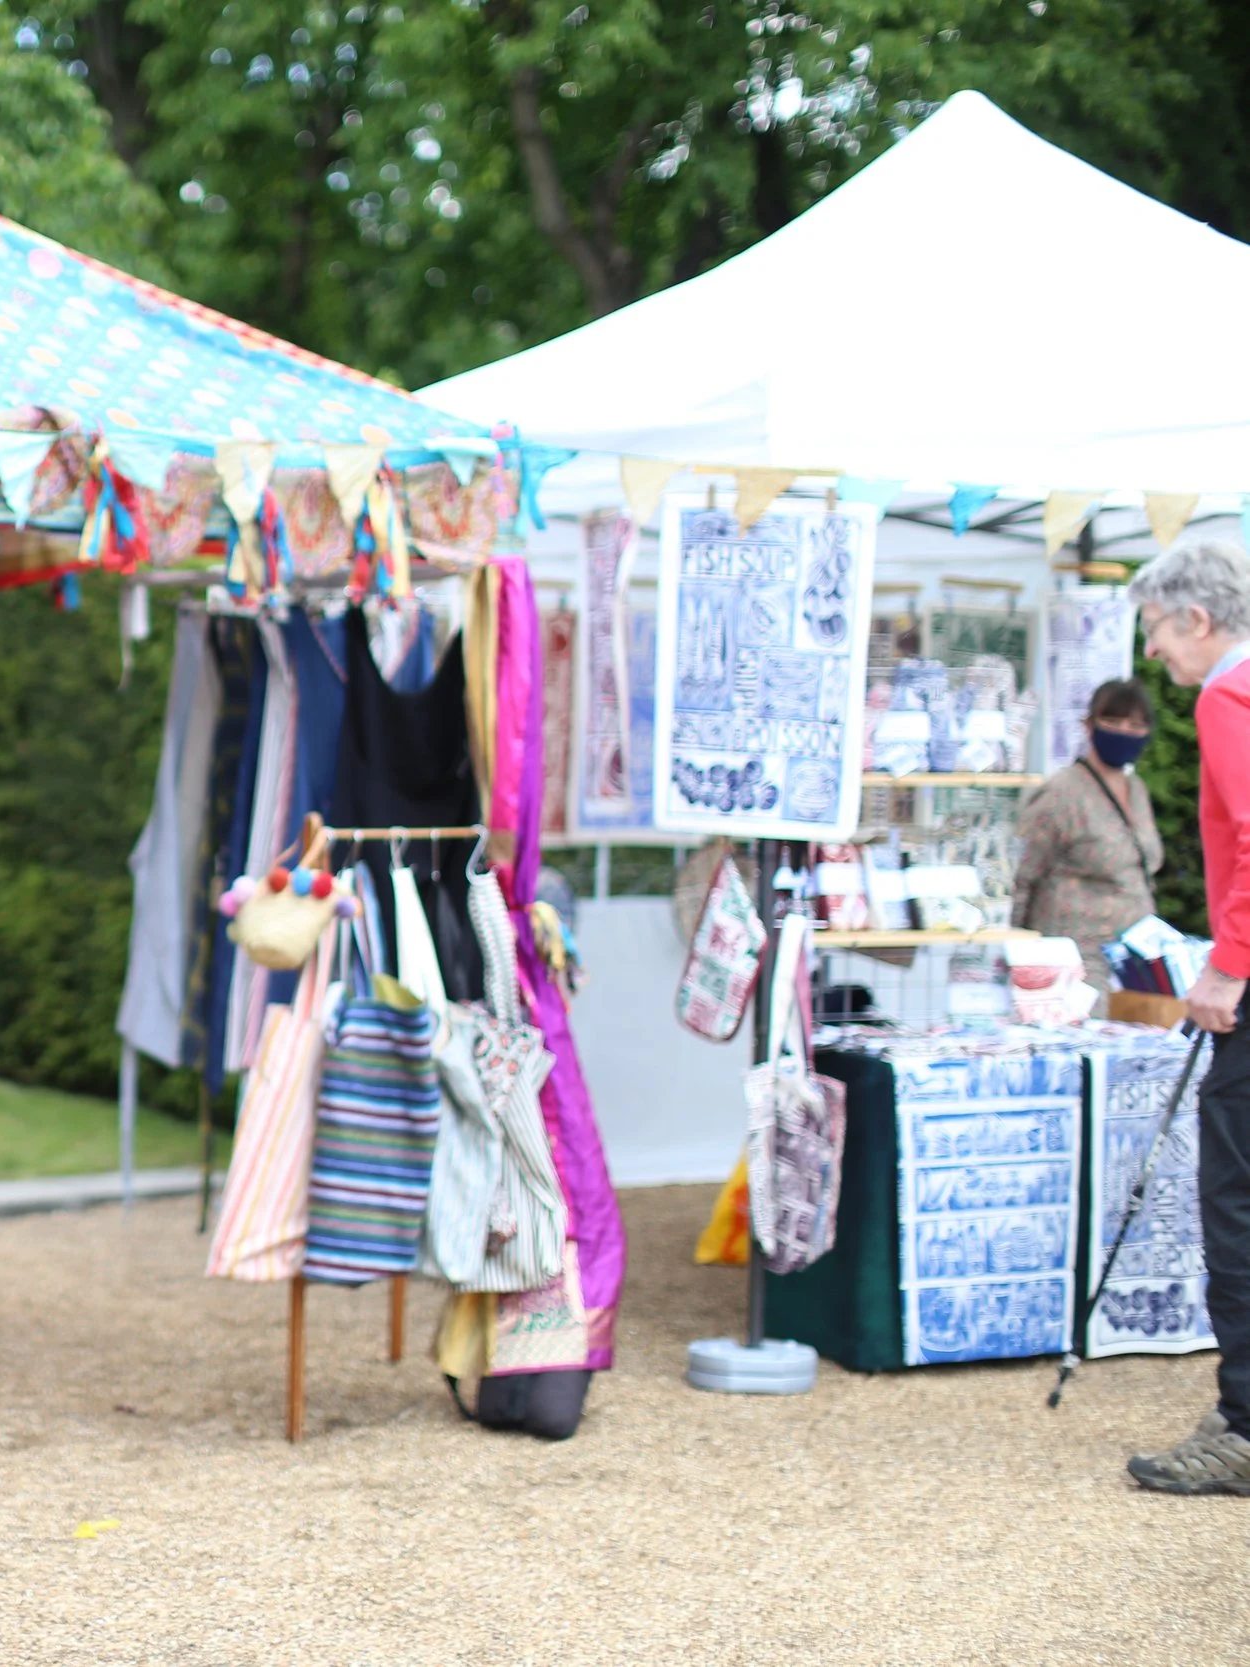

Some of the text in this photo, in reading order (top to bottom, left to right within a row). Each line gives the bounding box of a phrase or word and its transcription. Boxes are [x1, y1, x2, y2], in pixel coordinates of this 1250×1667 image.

[681, 543, 795, 578] FISH SOUP
[746, 719, 842, 756] POISSON
